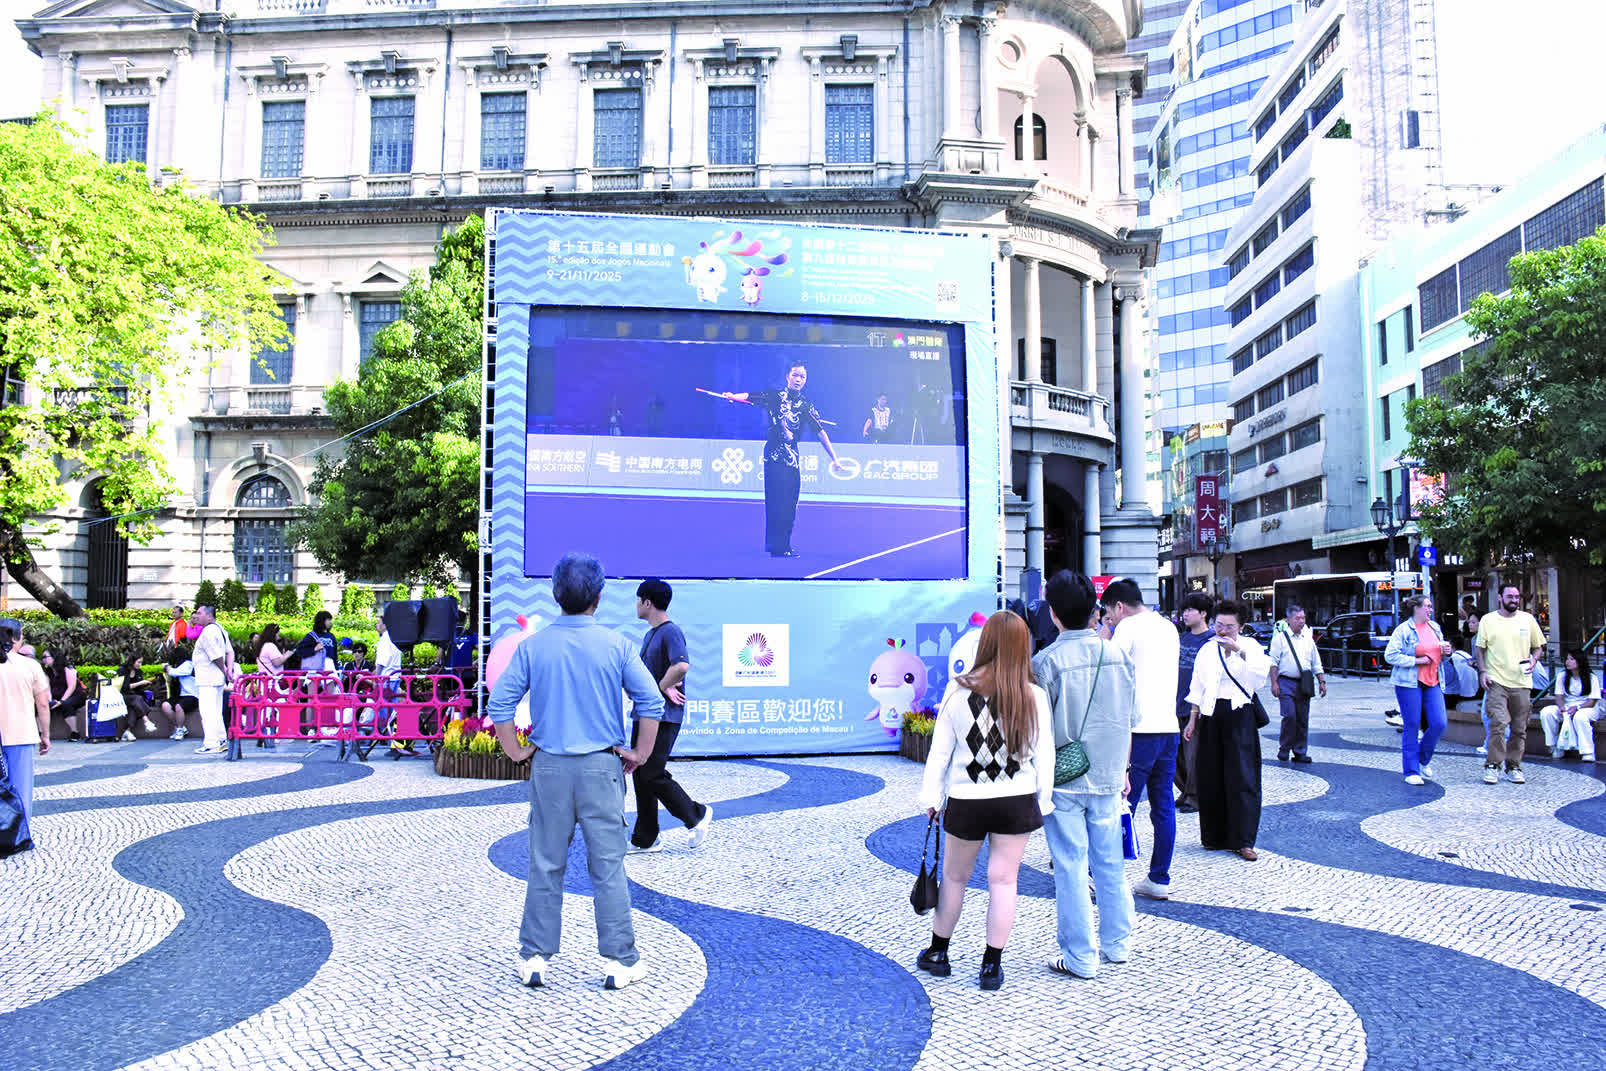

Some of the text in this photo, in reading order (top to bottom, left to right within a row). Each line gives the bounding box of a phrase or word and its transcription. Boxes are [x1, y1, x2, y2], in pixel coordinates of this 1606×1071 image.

[546, 269, 622, 281] 9-21/11/2025
[542, 463, 586, 472] SOUTHERN
[624, 455, 704, 470] 中国南方电网
[892, 472, 940, 481] GROUP
[1199, 480, 1217, 545] 周大福
[685, 698, 844, 724] 門賽區歡迎您!
[724, 727, 746, 736] Zona
[747, 726, 758, 735] de
[759, 725, 809, 737] Competição
[810, 725, 821, 735] de
[822, 725, 849, 734] Macau
